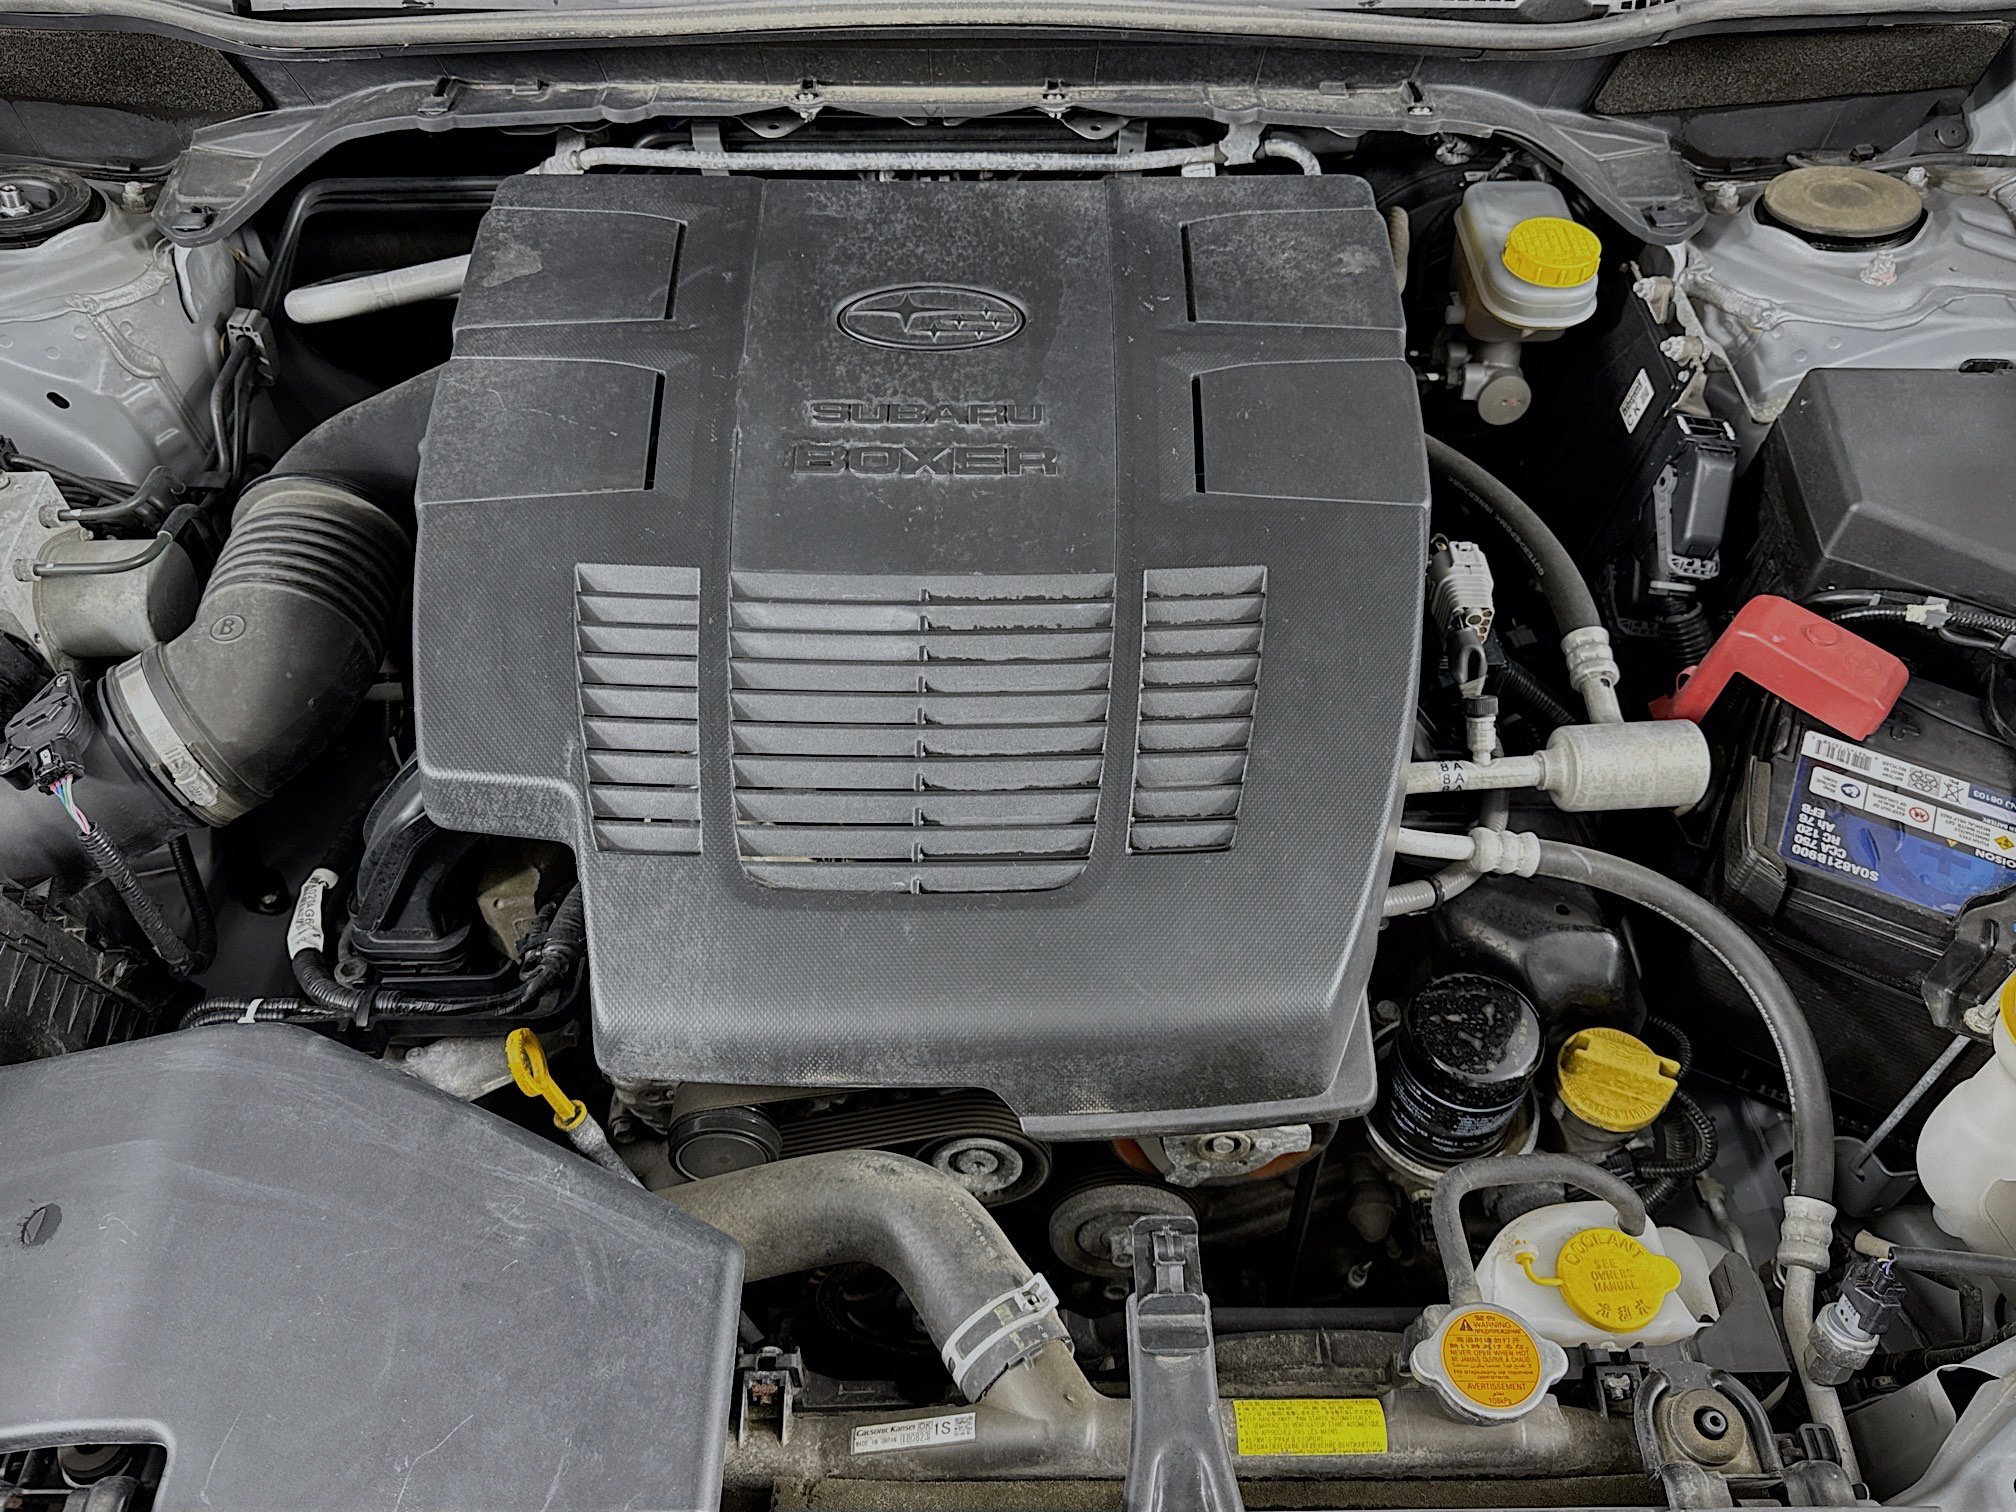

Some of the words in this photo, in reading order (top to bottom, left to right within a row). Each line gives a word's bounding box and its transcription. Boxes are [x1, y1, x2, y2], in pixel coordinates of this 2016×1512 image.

[810, 402, 1045, 426] SUBARU
[794, 444, 1060, 476] BOXER
[1973, 790, 2003, 805] 08103
[1801, 803, 1826, 818] EFB
[1798, 813, 1815, 825] 76
[1817, 819, 1836, 833] Ah
[1796, 823, 1820, 839] 120
[1794, 834, 1818, 850] 750
[1822, 832, 1841, 846] RC
[1820, 841, 1847, 859] CCA
[1565, 1232, 1645, 1265] COOLANT
[1593, 1258, 1618, 1270] SEE
[1591, 1268, 1634, 1281] OWNERS
[1593, 1280, 1640, 1293] MANUAL
[1473, 1321, 1511, 1329] WARNING
[1467, 1382, 1526, 1391] AVERTISSEMENT
[1488, 1397, 1513, 1405] 108kPa
[890, 1424, 916, 1433] Kansei
